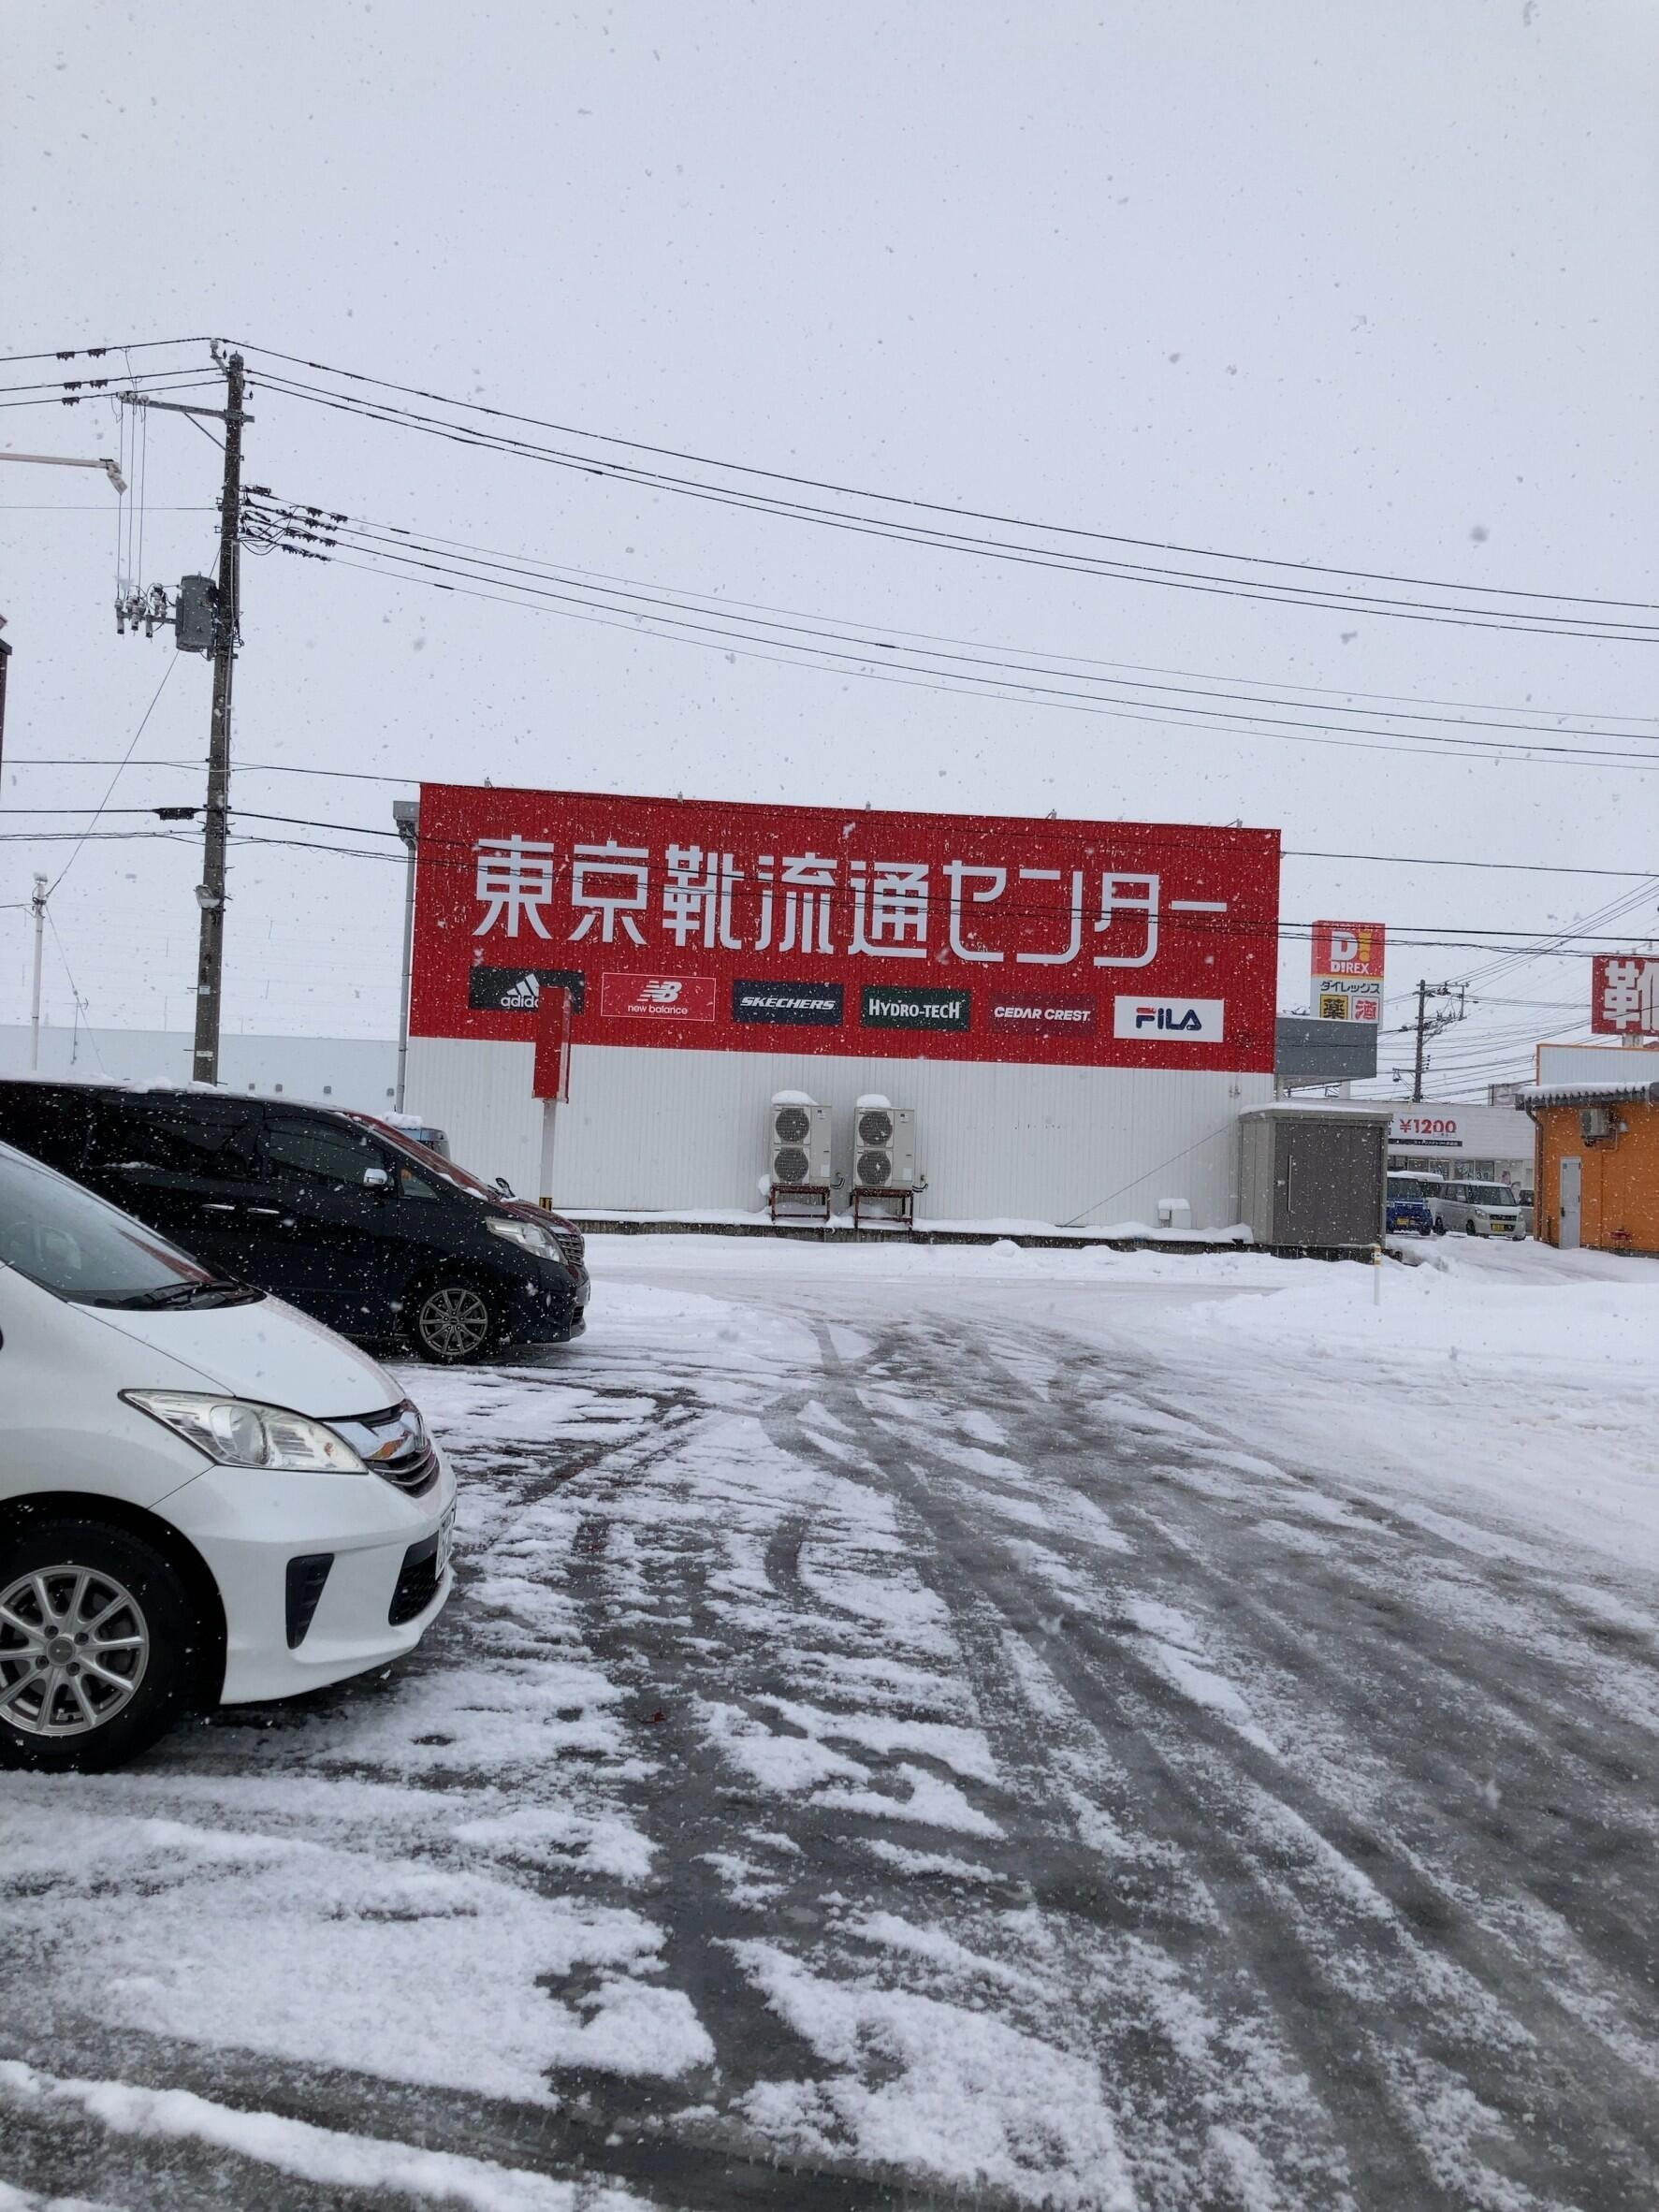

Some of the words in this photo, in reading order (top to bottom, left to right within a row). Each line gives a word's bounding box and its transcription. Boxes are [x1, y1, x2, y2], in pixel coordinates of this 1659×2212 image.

[473, 835, 1228, 968] 東京靴流通センター
[1319, 980, 1381, 994] ダイレックス
[628, 1004, 647, 1013] new
[648, 1005, 689, 1015] balance
[739, 997, 837, 1011] SKECHERS
[1355, 1000, 1377, 1020] 酒
[994, 1006, 1041, 1020] CEDAR
[1136, 1007, 1202, 1031] FILA
[1400, 1118, 1458, 1134] ¥1200
